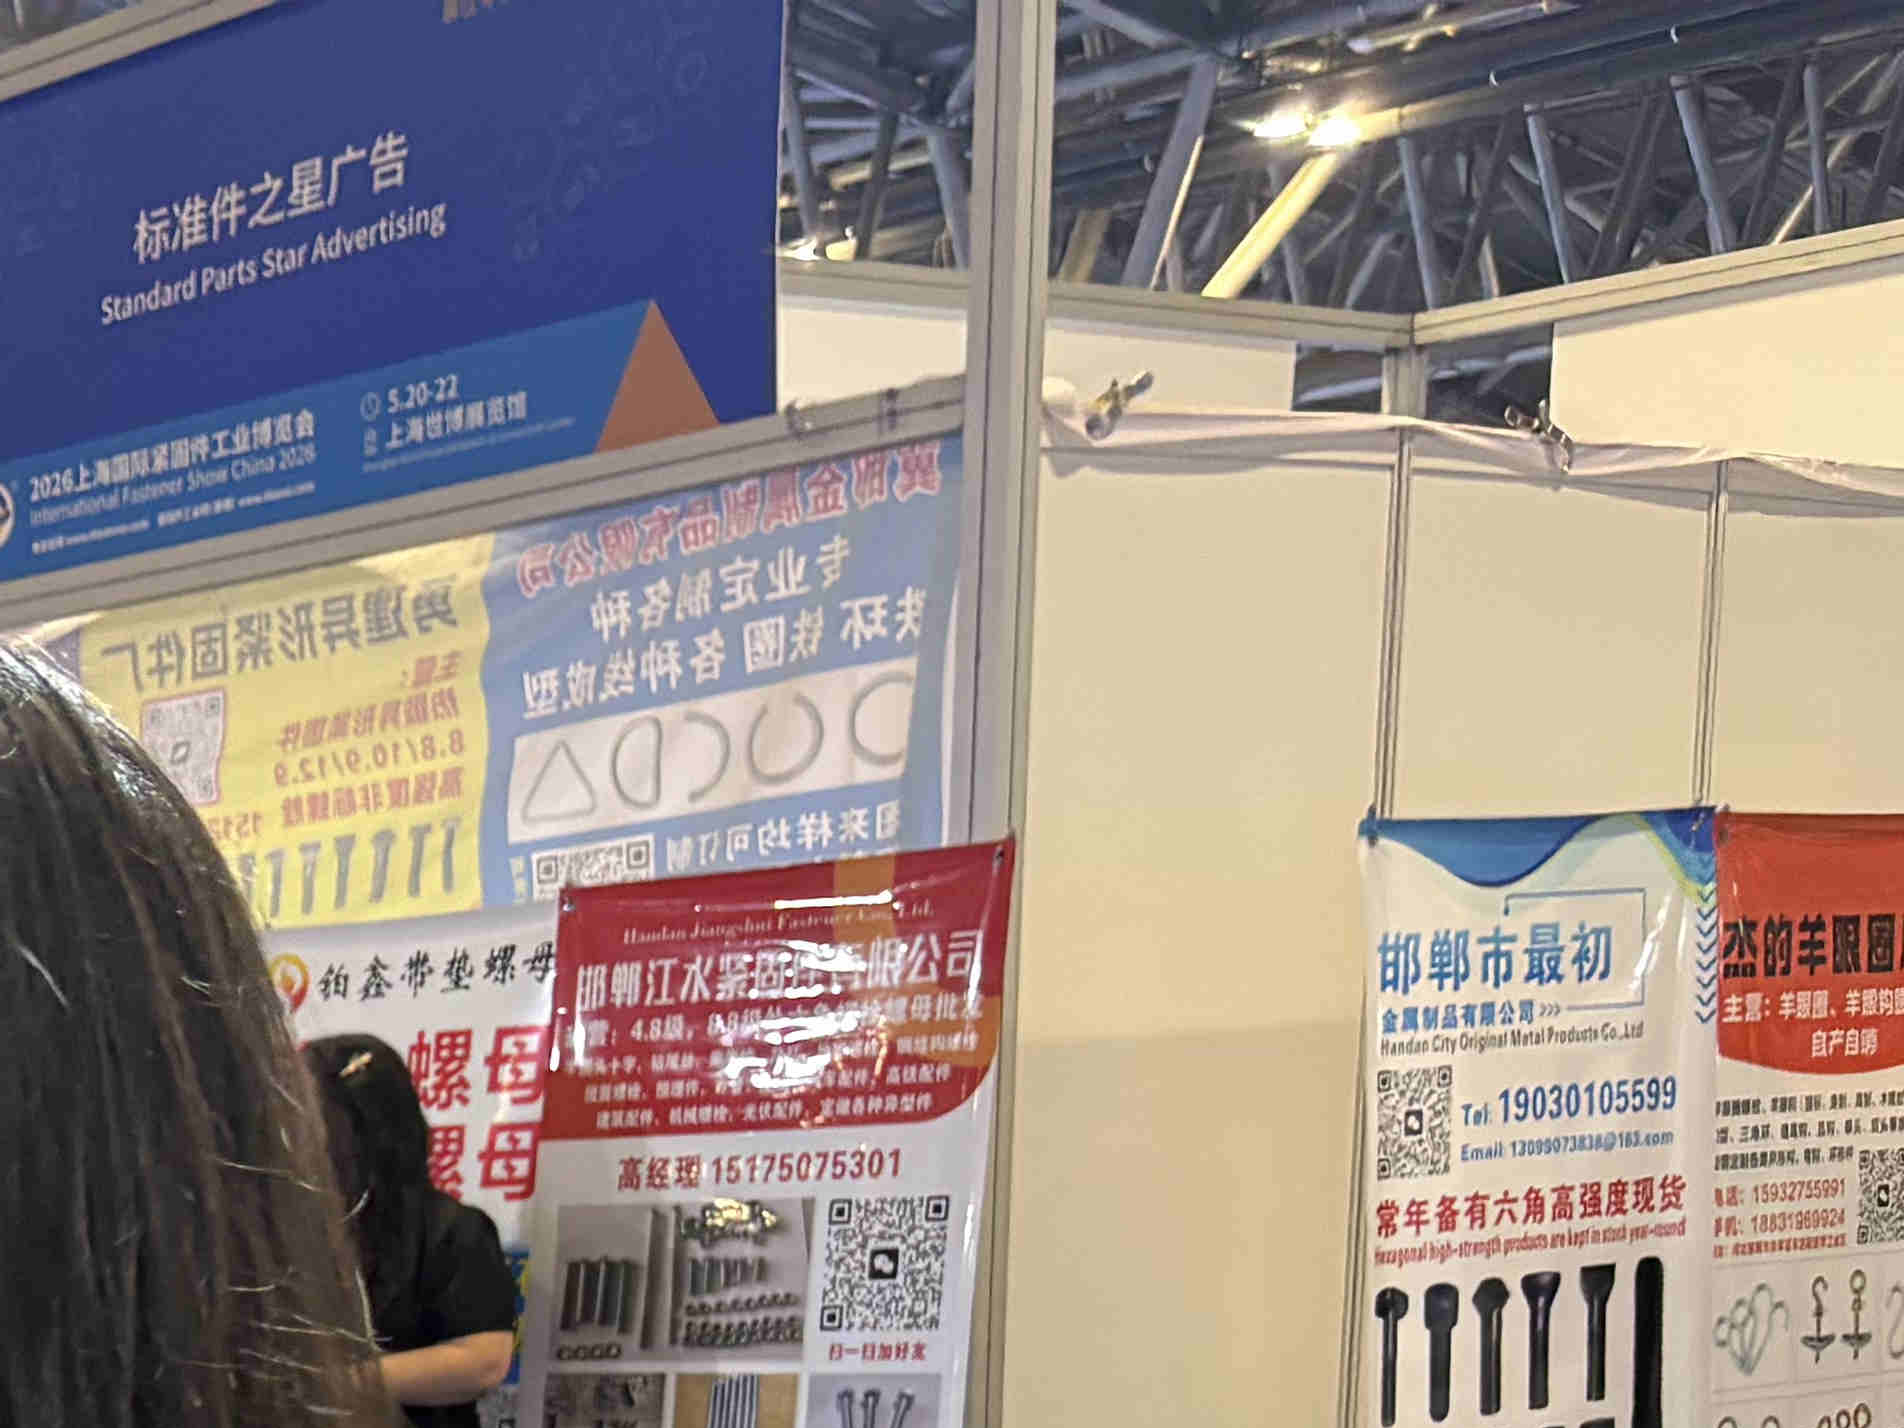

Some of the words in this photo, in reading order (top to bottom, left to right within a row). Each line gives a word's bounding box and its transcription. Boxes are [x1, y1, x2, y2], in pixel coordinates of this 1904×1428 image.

[133, 130, 408, 264] 标准件之星广告
[101, 270, 197, 325] Standard
[201, 256, 257, 296] Parts
[261, 241, 307, 279] Star
[310, 201, 448, 265] Advertising
[387, 374, 459, 414] 5.20-22
[385, 391, 528, 448] 上海世博展览馆
[1377, 920, 1612, 996] 邯郸市最初
[1382, 999, 1534, 1034] 金属制品有限公司
[1380, 1031, 1430, 1056] Handan
[1432, 1031, 1457, 1054] City
[1460, 1029, 1509, 1053] Original
[1812, 1027, 1879, 1058] 自产自销
[1499, 1074, 1678, 1124] 19030105599
[618, 1154, 702, 1192] 高经理
[711, 1148, 903, 1186] 15175075301
[1376, 1174, 1687, 1239] 常年备有六角高强度现货
[828, 1343, 926, 1362] 扫一扫加好友
